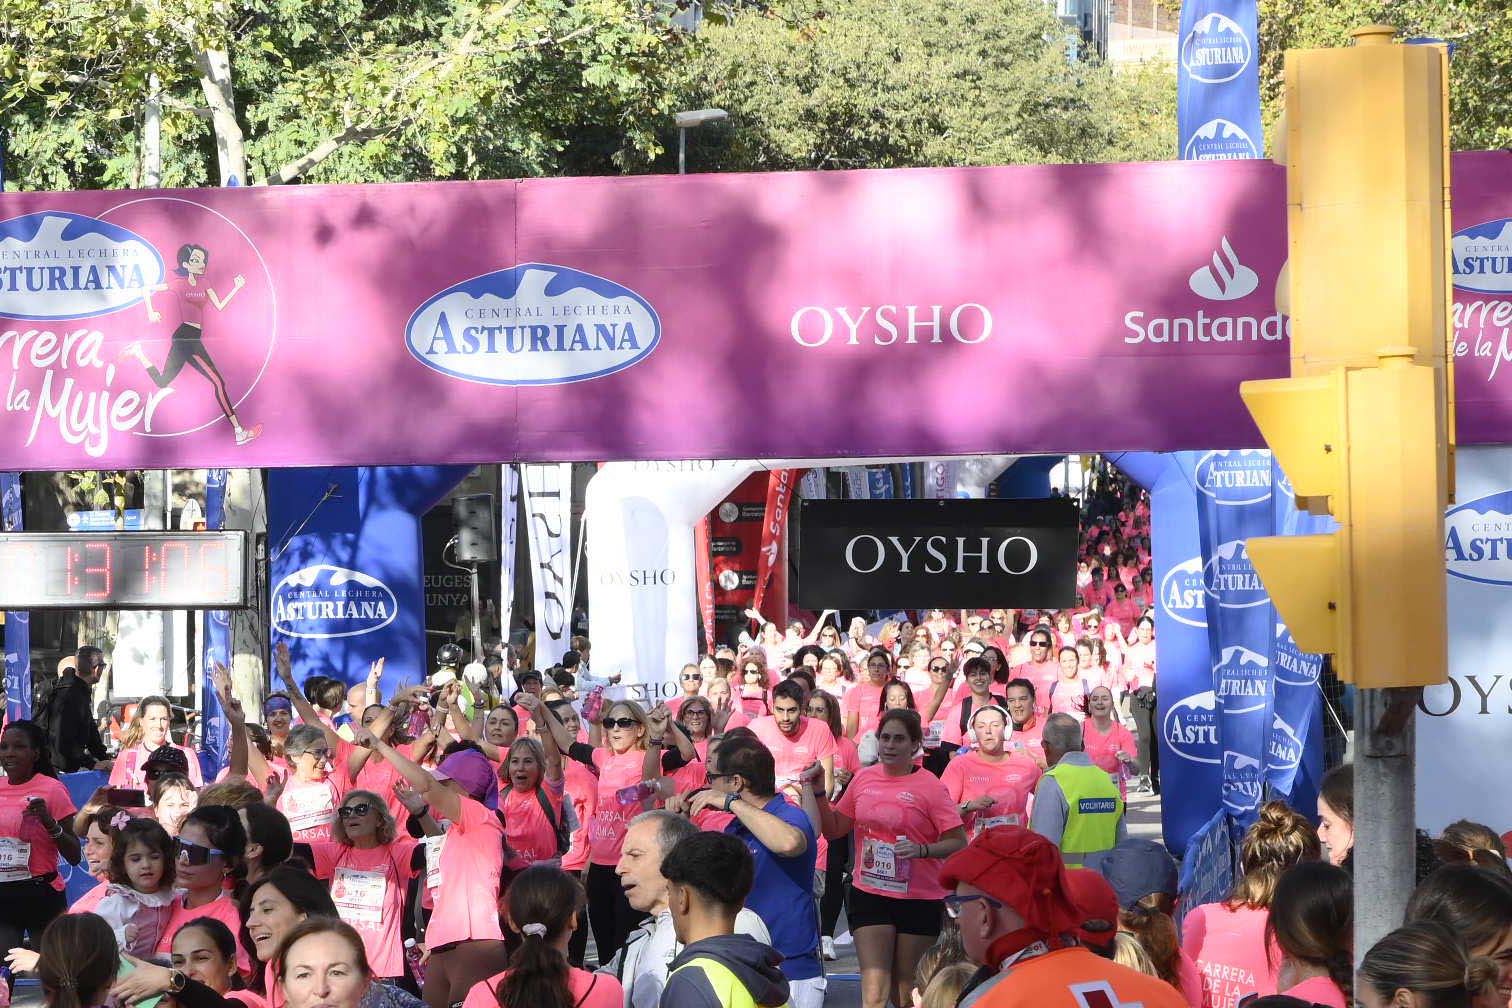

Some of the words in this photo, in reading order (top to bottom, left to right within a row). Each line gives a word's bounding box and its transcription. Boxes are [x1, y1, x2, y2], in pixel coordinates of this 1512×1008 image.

[68, 248, 139, 260] LECHERA
[464, 306, 544, 318] CENTRAL
[551, 304, 633, 317] LECHERA
[791, 303, 993, 348] OYSHO
[426, 310, 641, 356] ASTURIANA
[1124, 311, 1290, 345] Santand
[6, 374, 31, 411] la
[25, 362, 176, 457] Mujer
[845, 534, 1039, 575] OYSHO
[276, 595, 389, 622] ASTURIANA
[875, 860, 892, 871] 016
[1202, 978, 1221, 994] DE
[1224, 983, 1241, 998] LA
